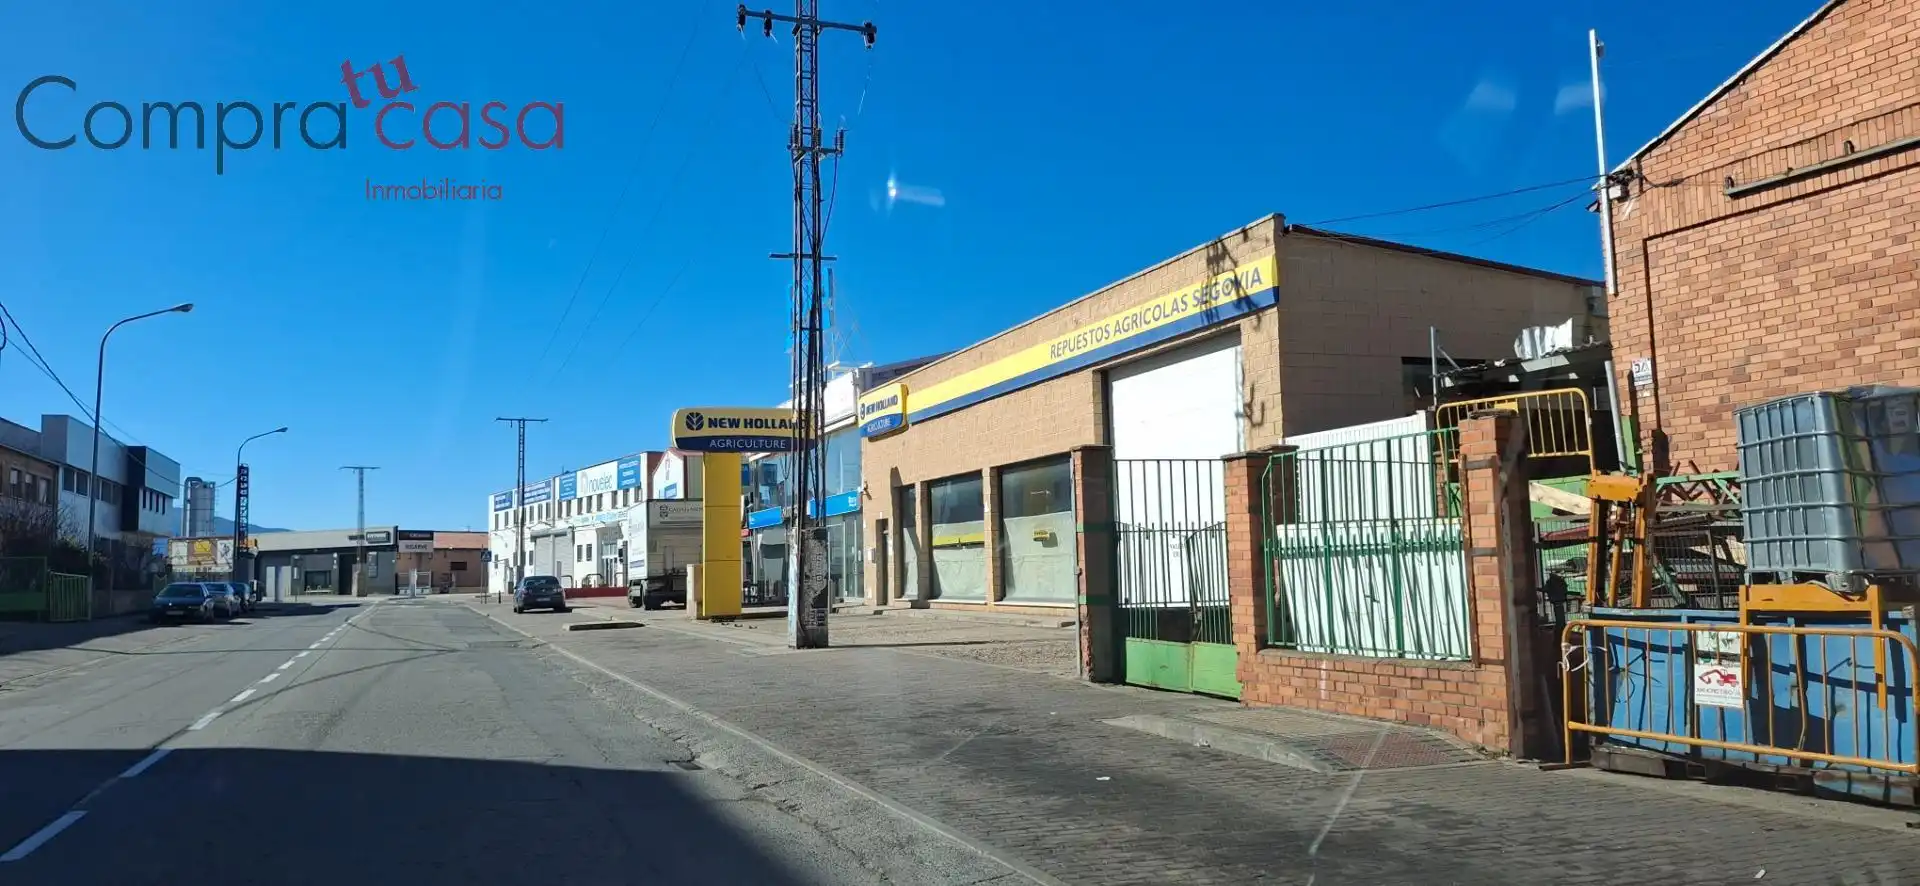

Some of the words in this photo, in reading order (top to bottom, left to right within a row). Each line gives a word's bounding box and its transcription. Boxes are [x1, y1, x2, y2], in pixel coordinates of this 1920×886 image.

[1050, 323, 1110, 359] REPUESTOS
[1192, 267, 1262, 307] SEGOVIA
[708, 417, 740, 429] NEW
[709, 439, 786, 449] AGRICULTURE
